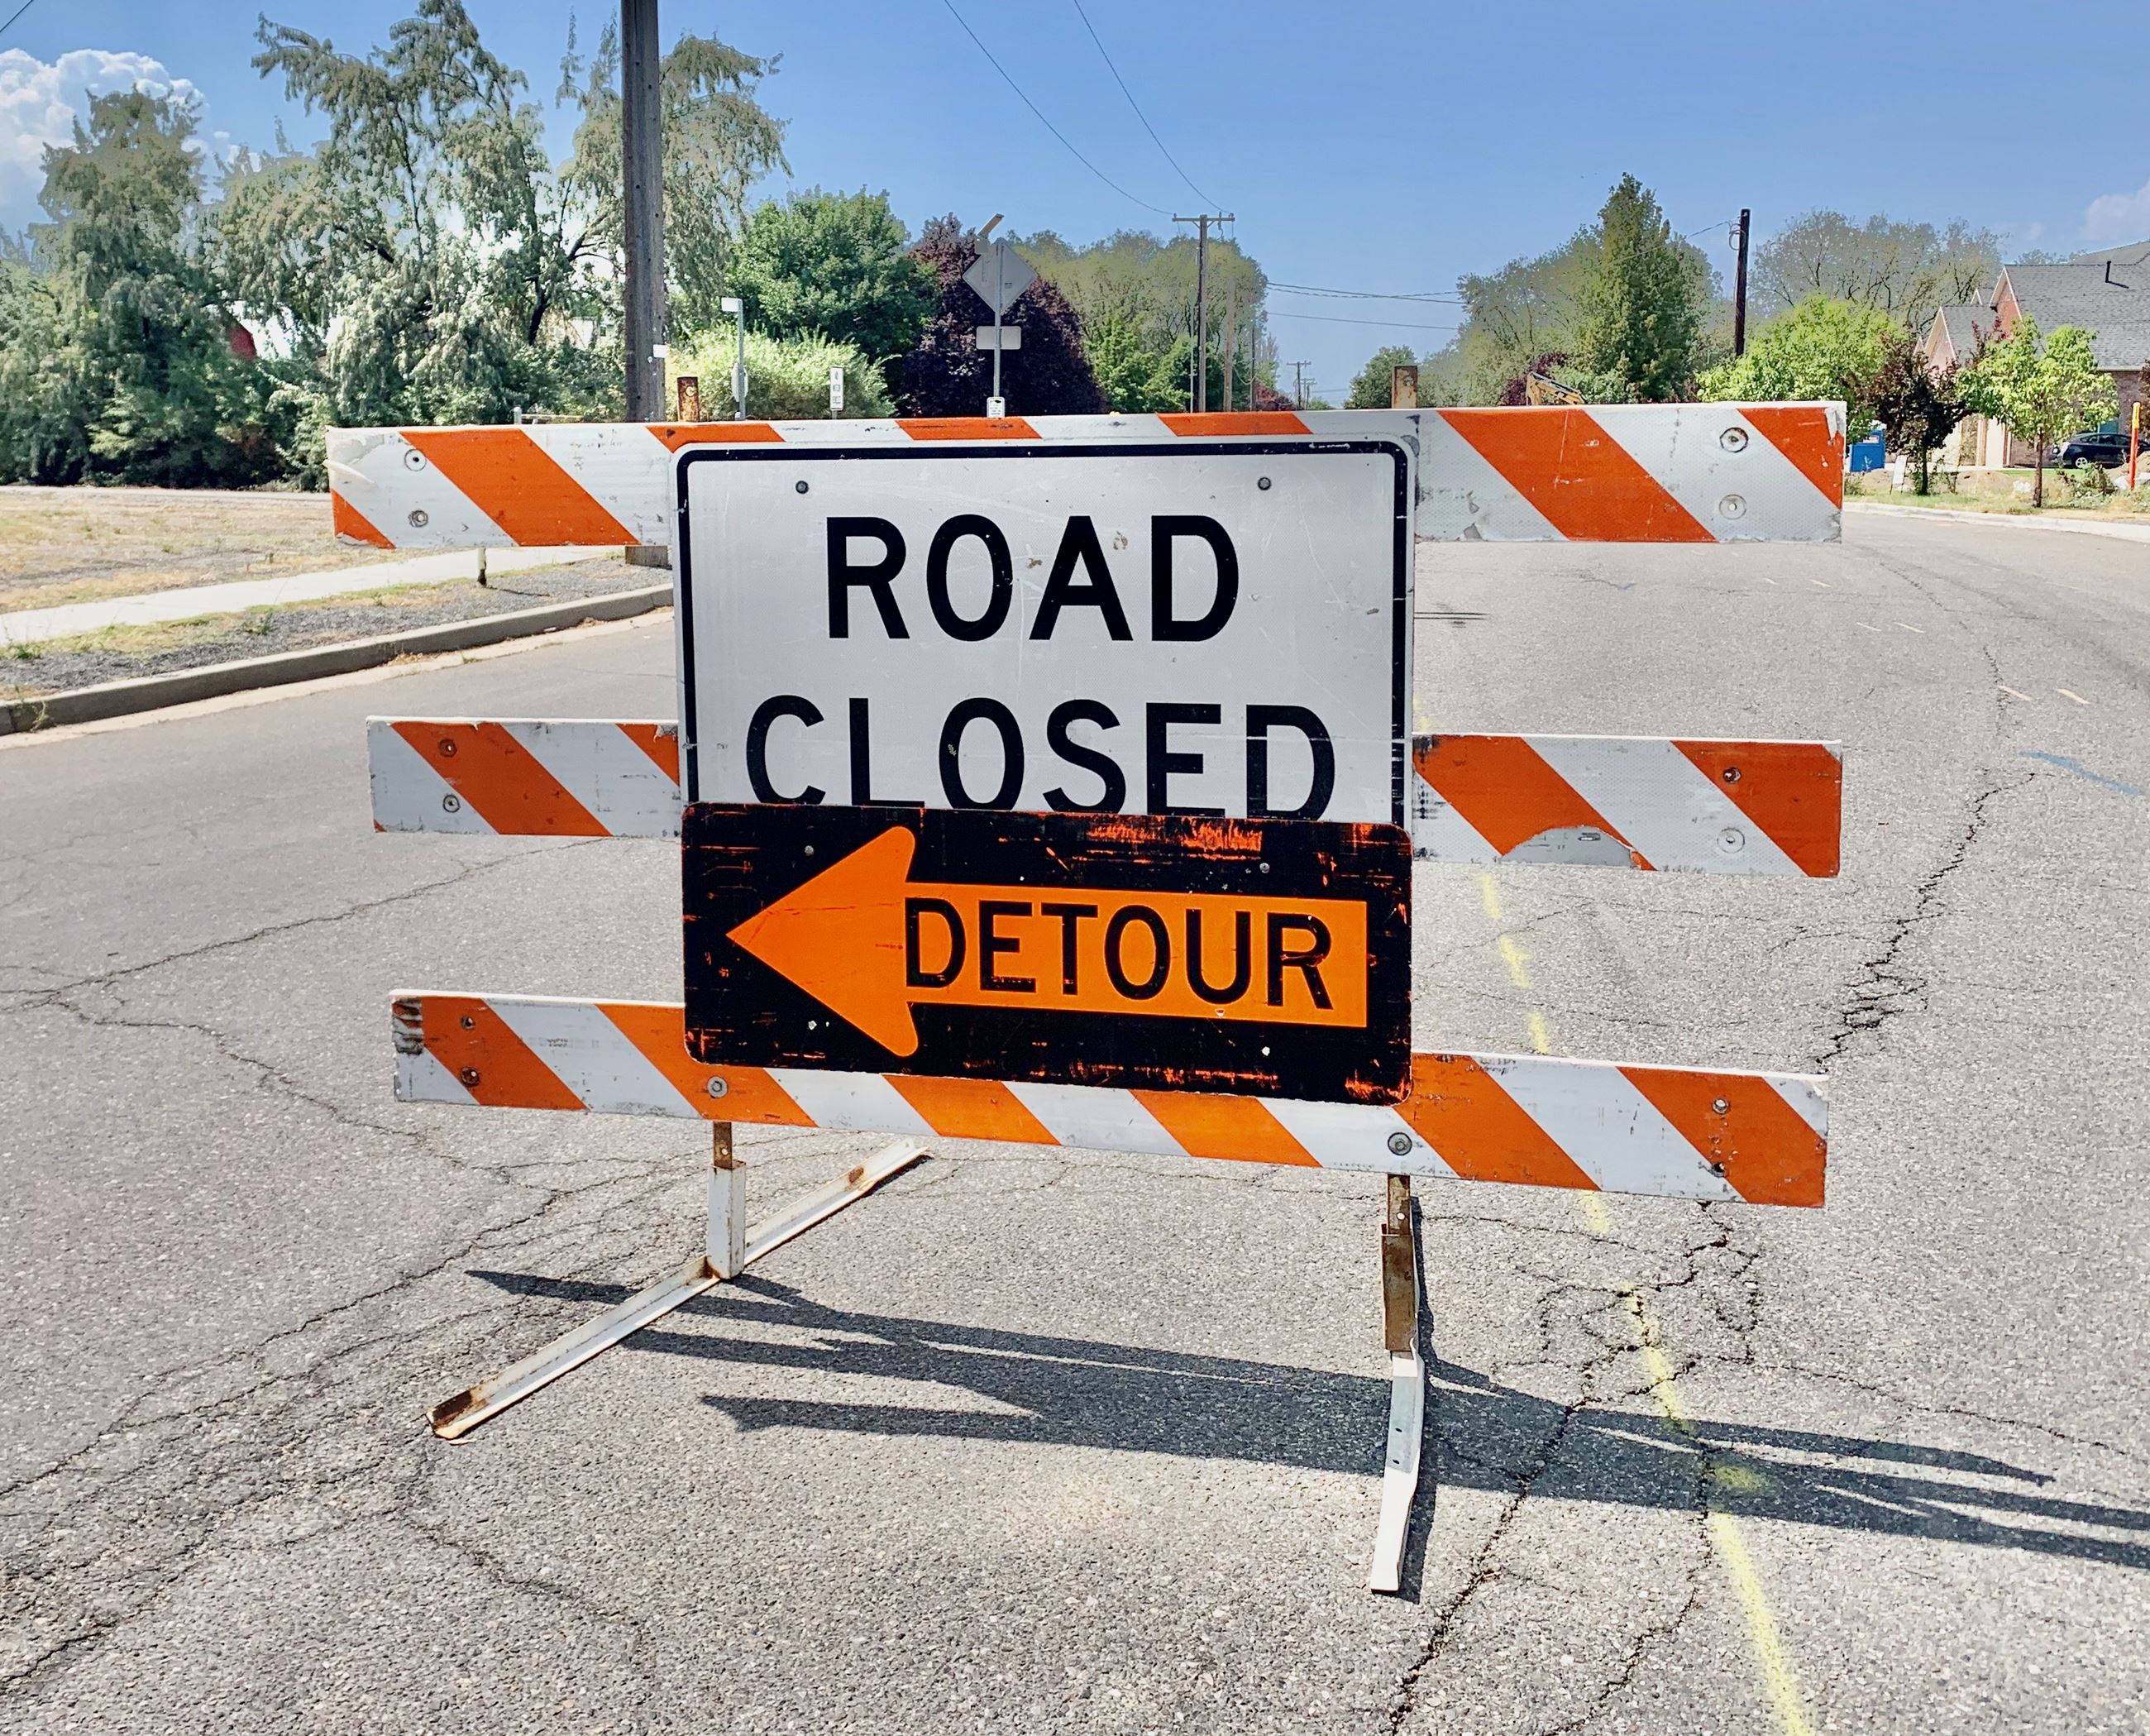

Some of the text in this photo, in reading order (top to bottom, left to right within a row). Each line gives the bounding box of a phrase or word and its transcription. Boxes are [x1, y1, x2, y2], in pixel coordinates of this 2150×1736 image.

[827, 514, 1239, 642] ROAD
[746, 696, 1335, 820] CLOSED
[906, 898, 1333, 1009] DETOUR
